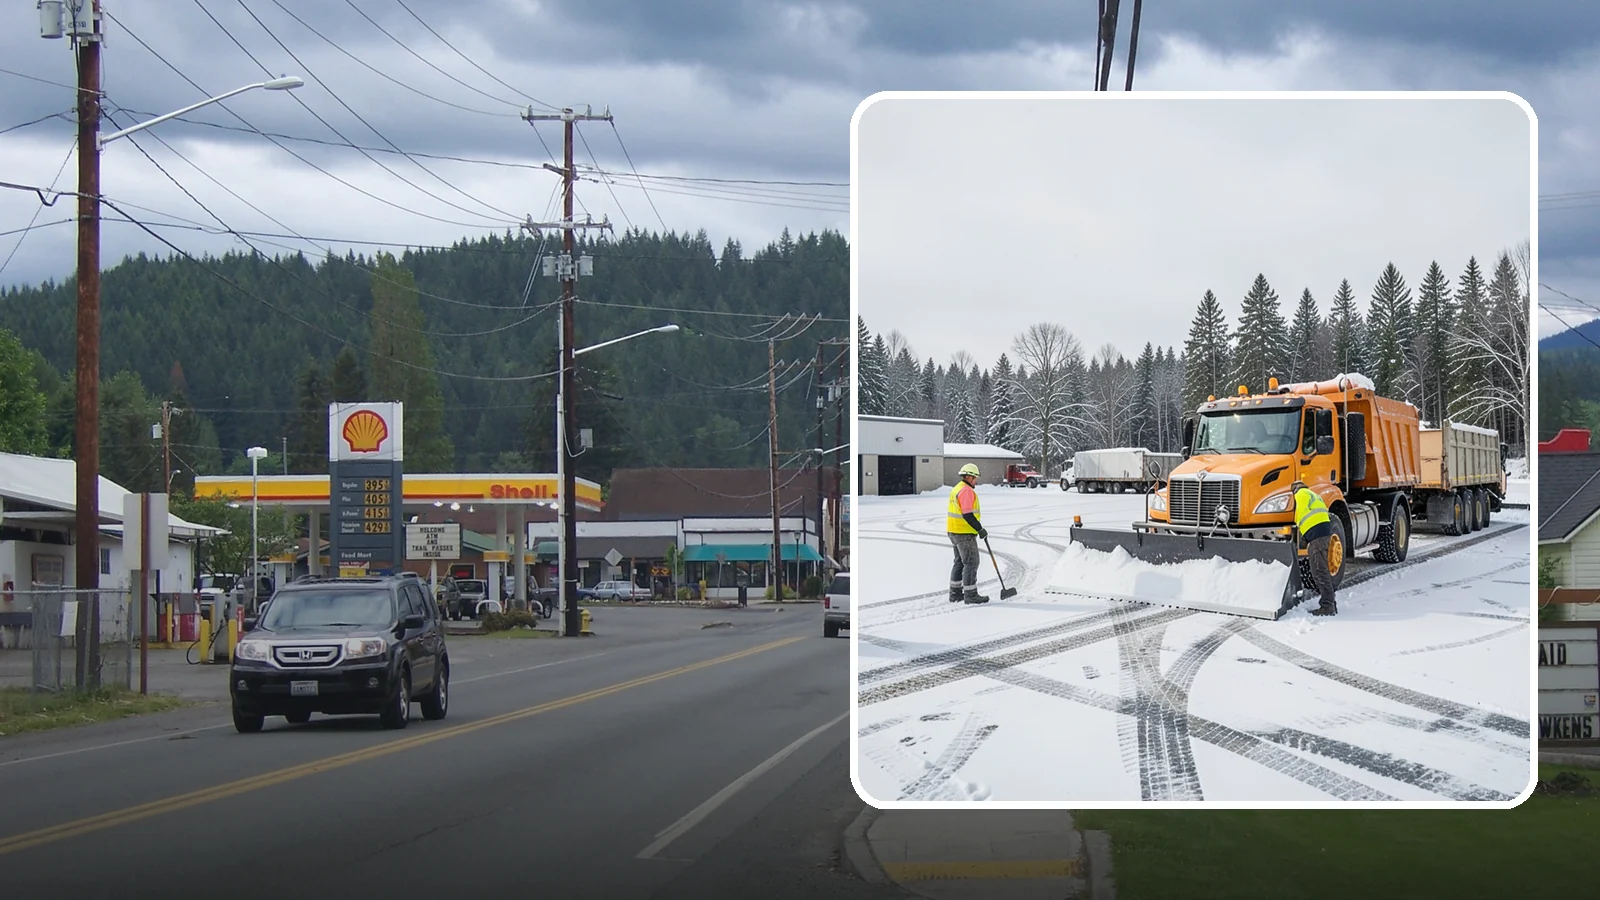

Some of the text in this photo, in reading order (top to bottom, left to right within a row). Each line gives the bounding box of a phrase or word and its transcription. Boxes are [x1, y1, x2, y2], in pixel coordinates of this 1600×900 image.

[366, 480, 383, 490] 395
[490, 484, 547, 499] Shell
[366, 494, 383, 504] 405
[366, 508, 383, 518] 415
[366, 522, 383, 532] 429
[1539, 642, 1567, 665] AID
